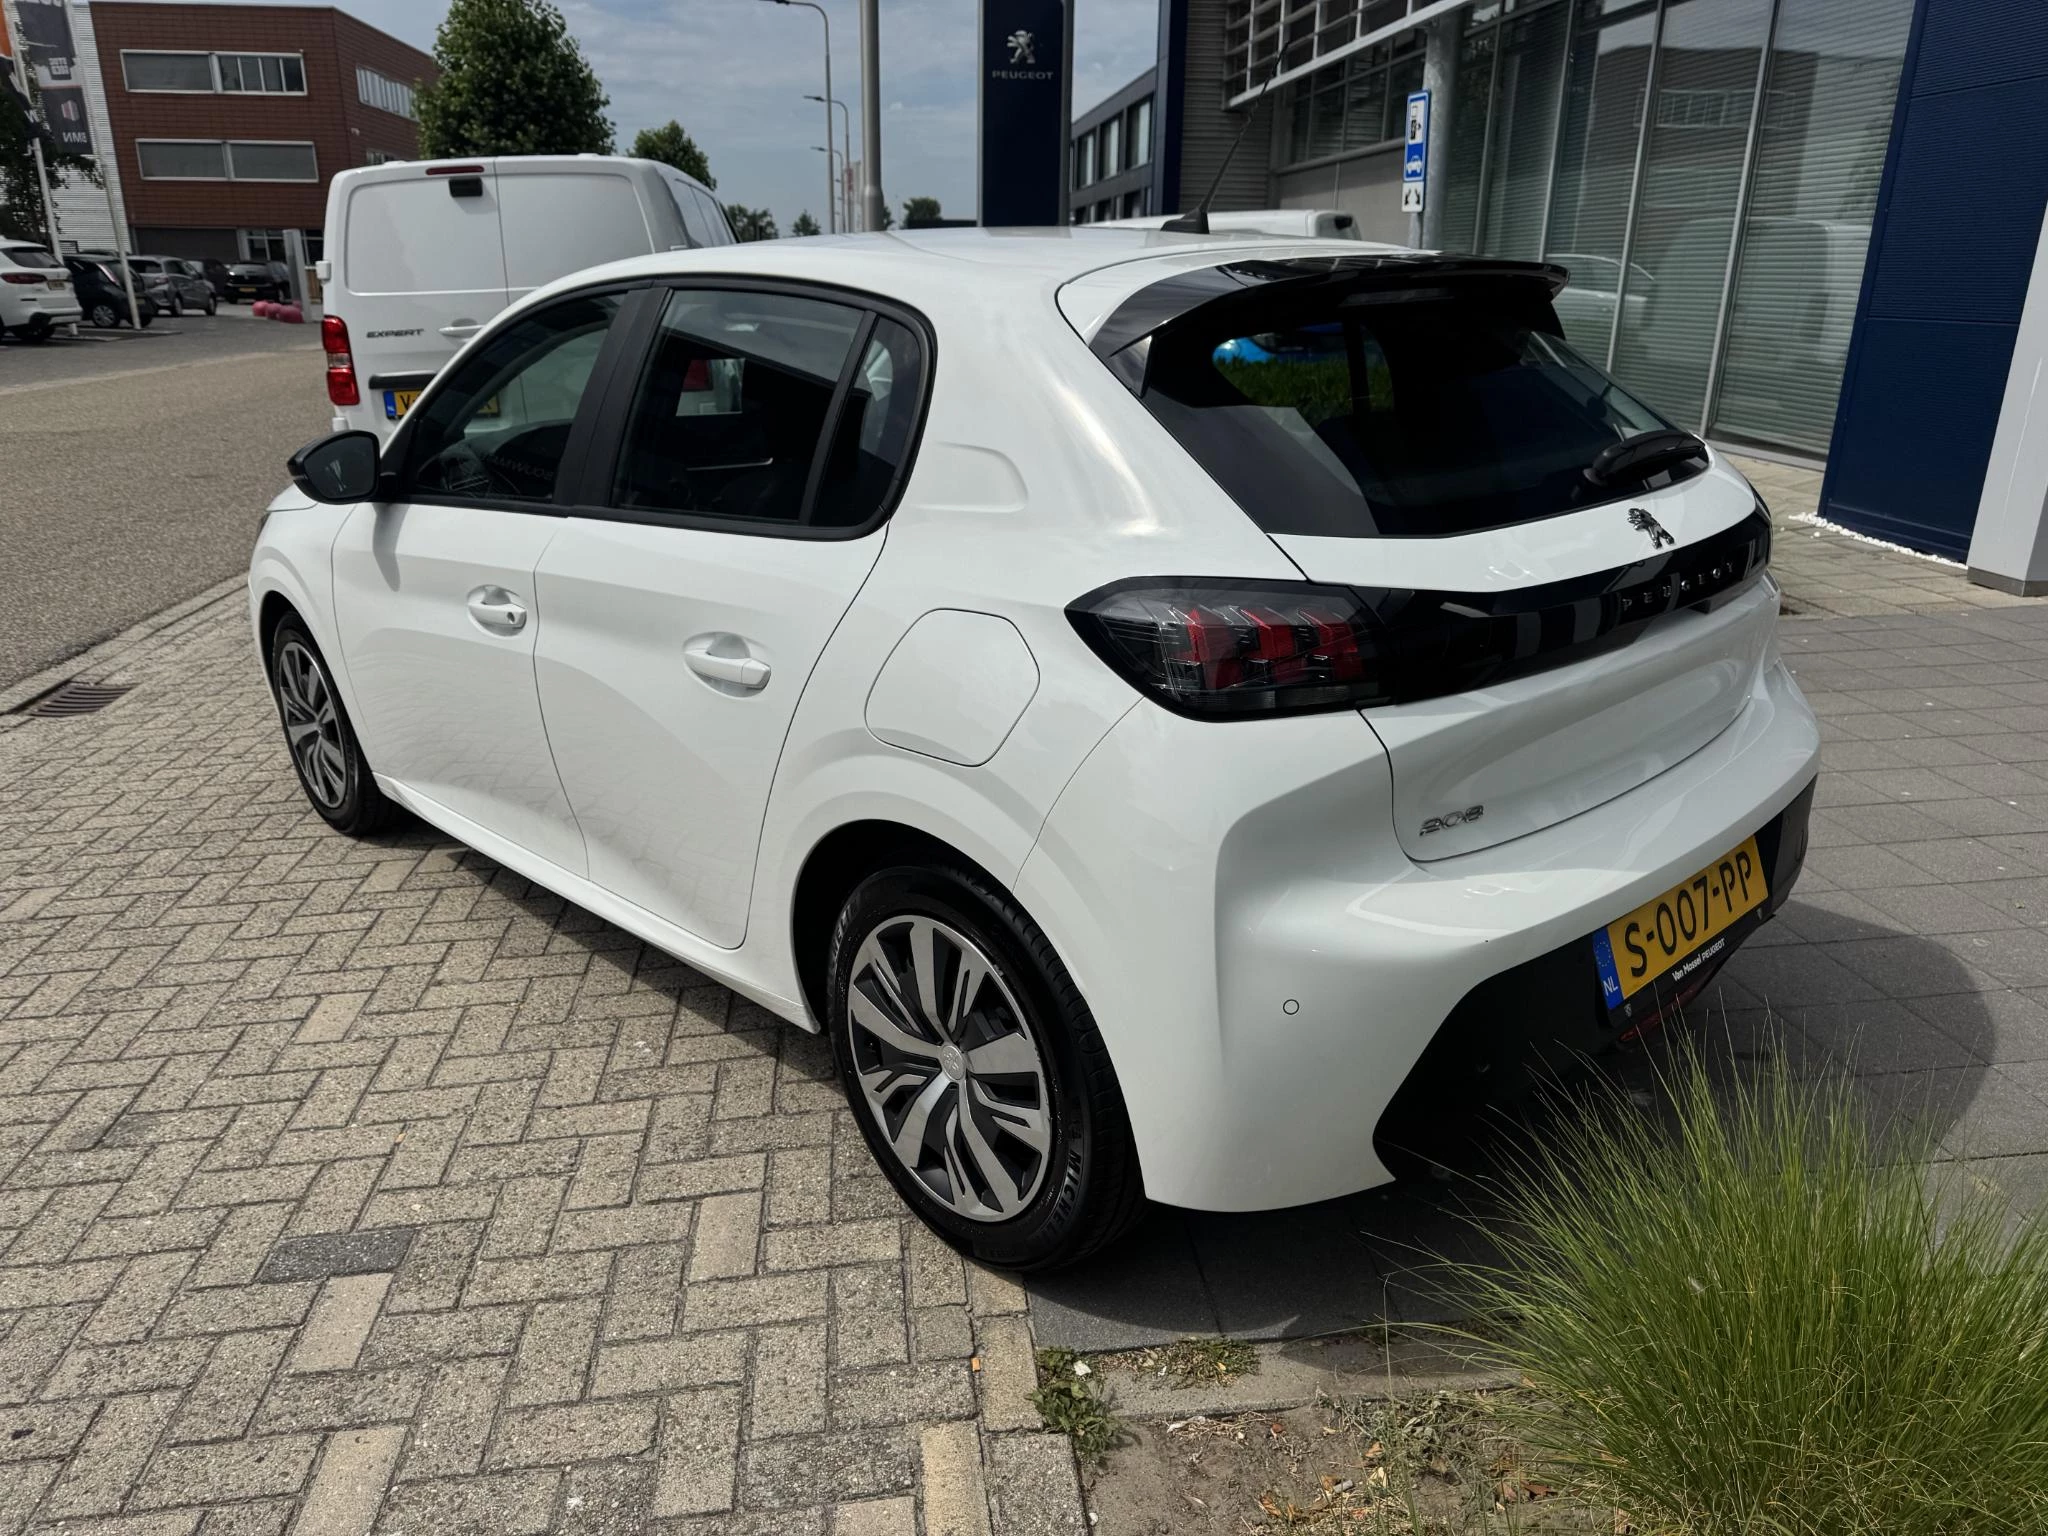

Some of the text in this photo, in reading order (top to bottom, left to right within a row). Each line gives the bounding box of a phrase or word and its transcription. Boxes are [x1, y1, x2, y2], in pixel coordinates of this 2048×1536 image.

[992, 70, 1054, 80] PEUGEOT
[366, 328, 425, 338] EXPERT
[1622, 561, 1733, 611] PEUGEOT
[1623, 850, 1752, 978] S-007-PP
[1671, 937, 1725, 981] Van Mossel PEUGEOT
[1603, 978, 1619, 996] NL
